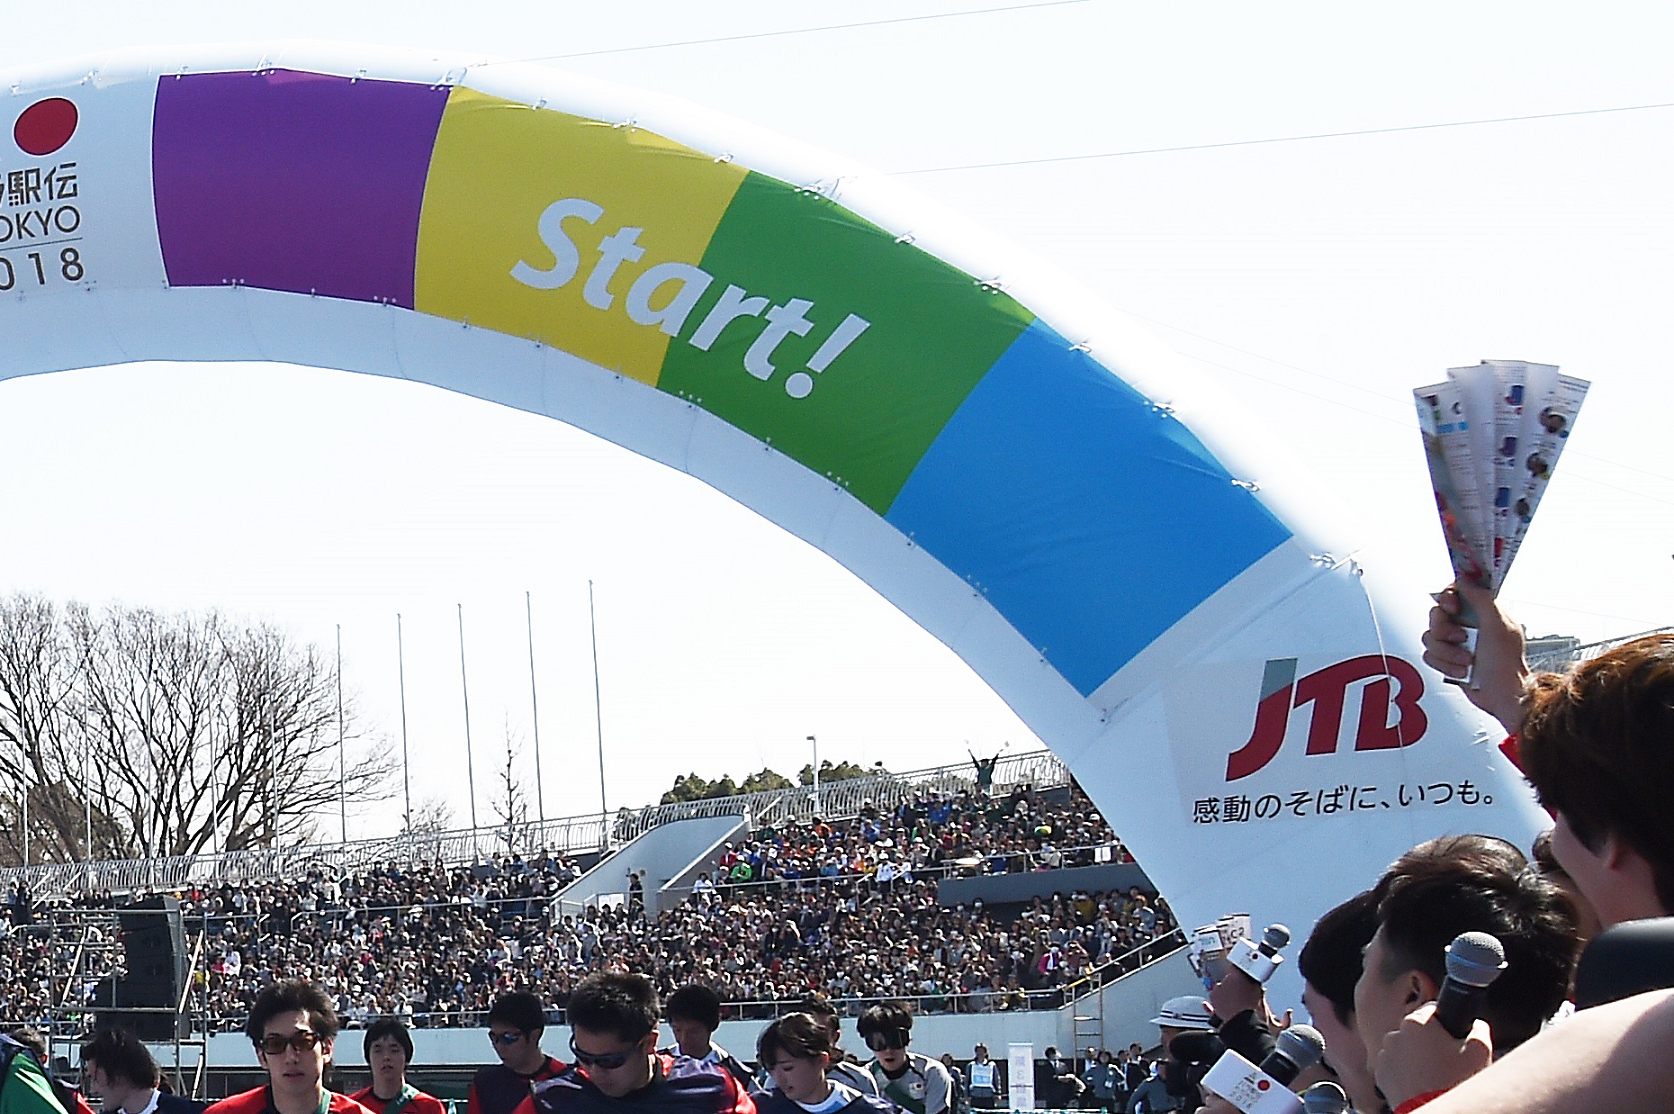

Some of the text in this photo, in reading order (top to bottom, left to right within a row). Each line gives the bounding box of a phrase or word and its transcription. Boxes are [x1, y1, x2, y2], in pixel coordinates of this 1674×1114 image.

[509, 197, 871, 399] Start!
[1226, 654, 1428, 782] JTB
[1193, 780, 1494, 824] 感動のそばに、いつも。
